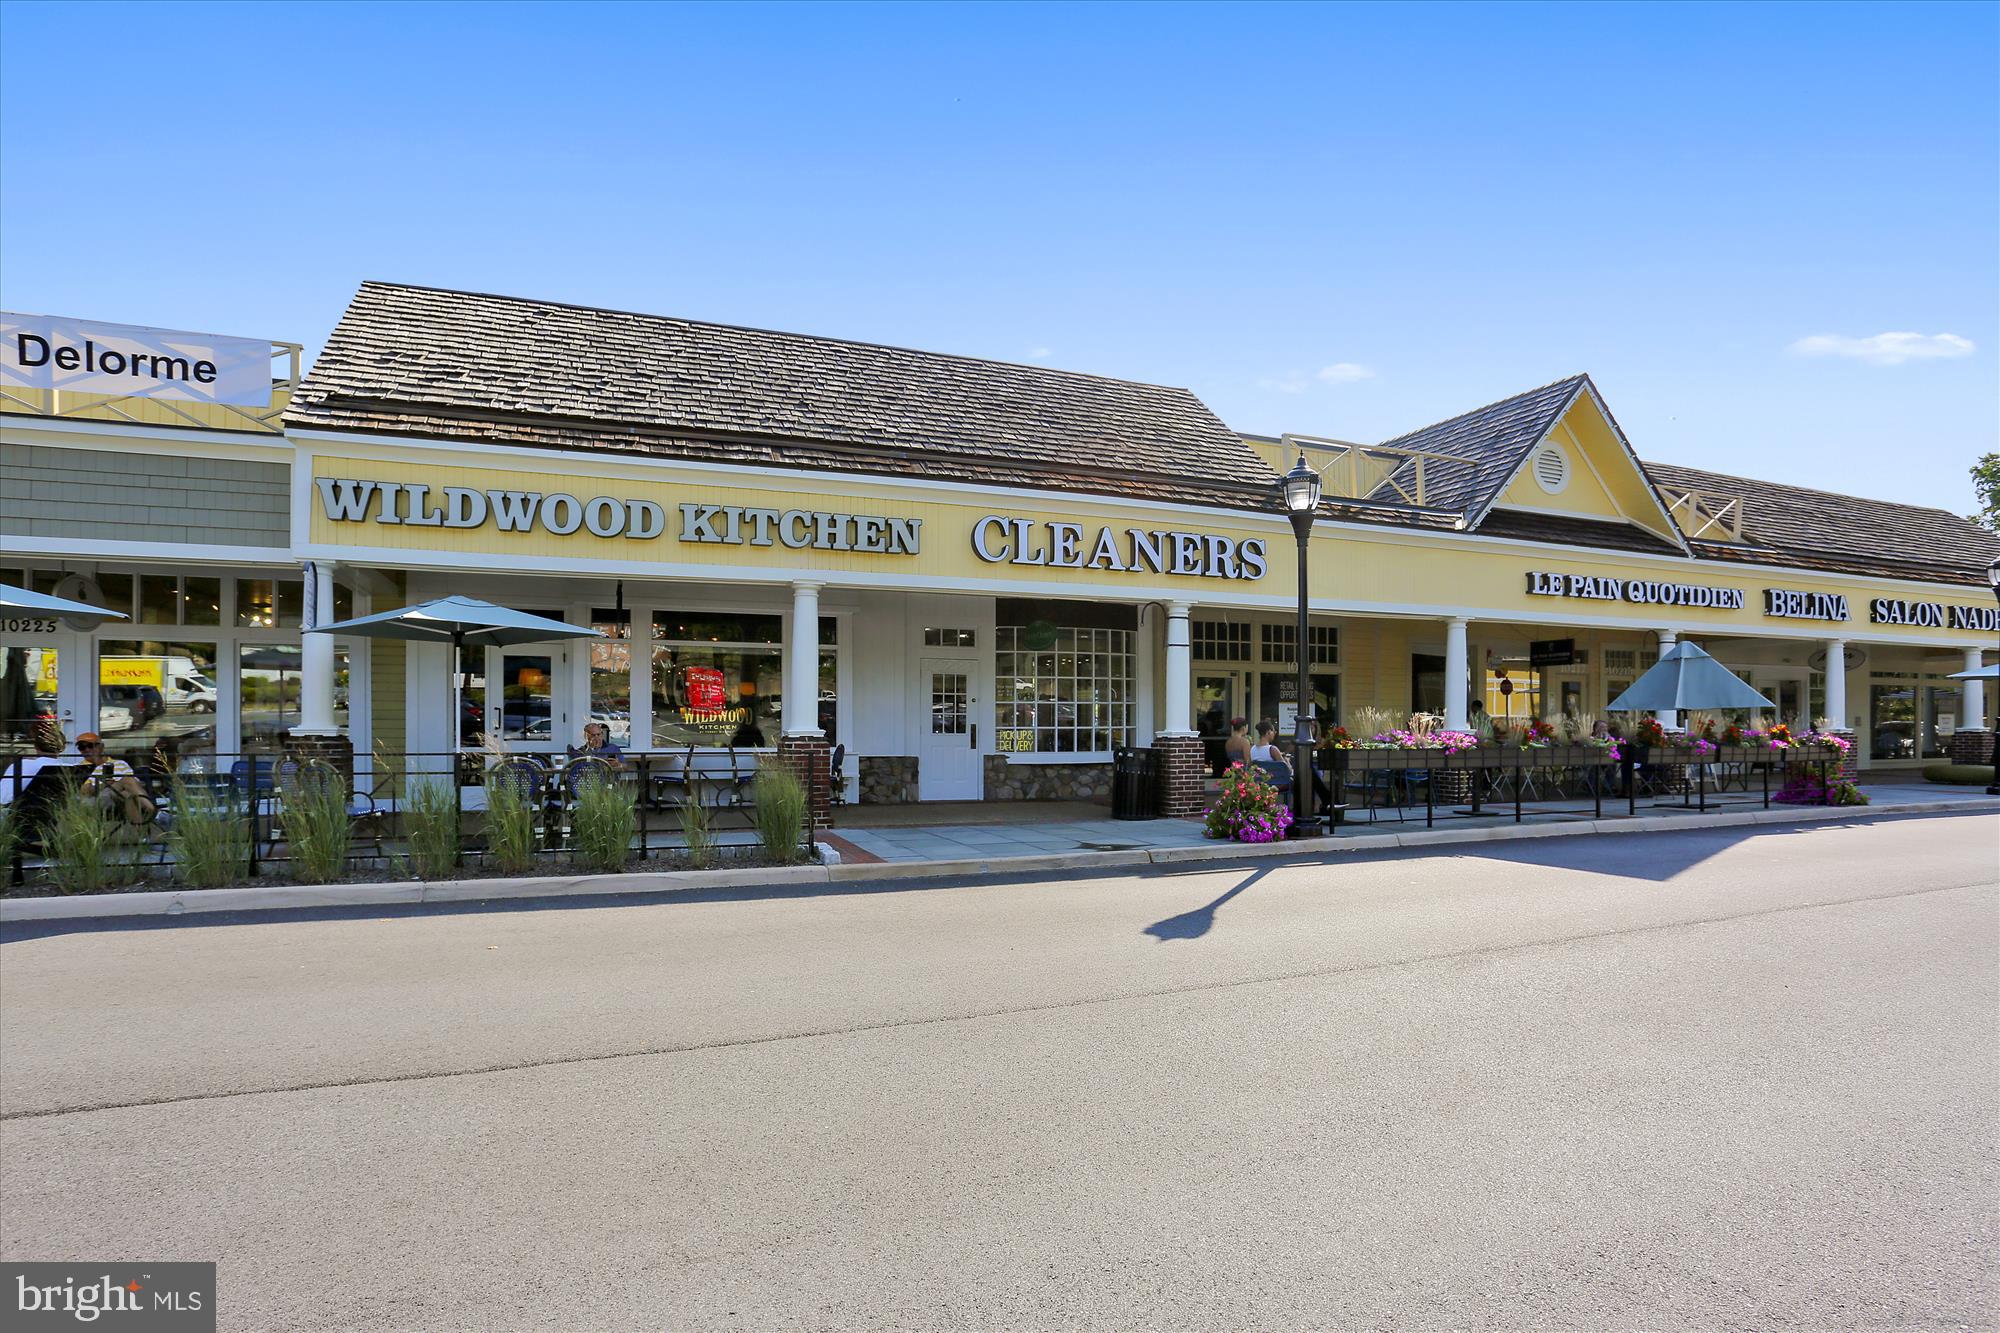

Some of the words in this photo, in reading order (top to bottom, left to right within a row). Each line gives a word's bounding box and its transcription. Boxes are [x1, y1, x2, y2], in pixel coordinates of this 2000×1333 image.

[17, 333, 217, 383] Delorme
[315, 477, 666, 540] WILDWOOD
[678, 503, 923, 555] KITCHEN
[970, 514, 1267, 581] CLEANERS
[1527, 572, 1564, 597] LE
[1567, 574, 1624, 600] PAIN
[1624, 579, 1745, 609] QUOTIDIEN
[1765, 588, 1852, 621] BELINA
[1, 619, 57, 633] 10225
[1873, 598, 1945, 628] SALON
[1288, 661, 1318, 673] 109
[684, 706, 753, 725] WILDWOOD
[1000, 740, 1034, 751] DELVERY
